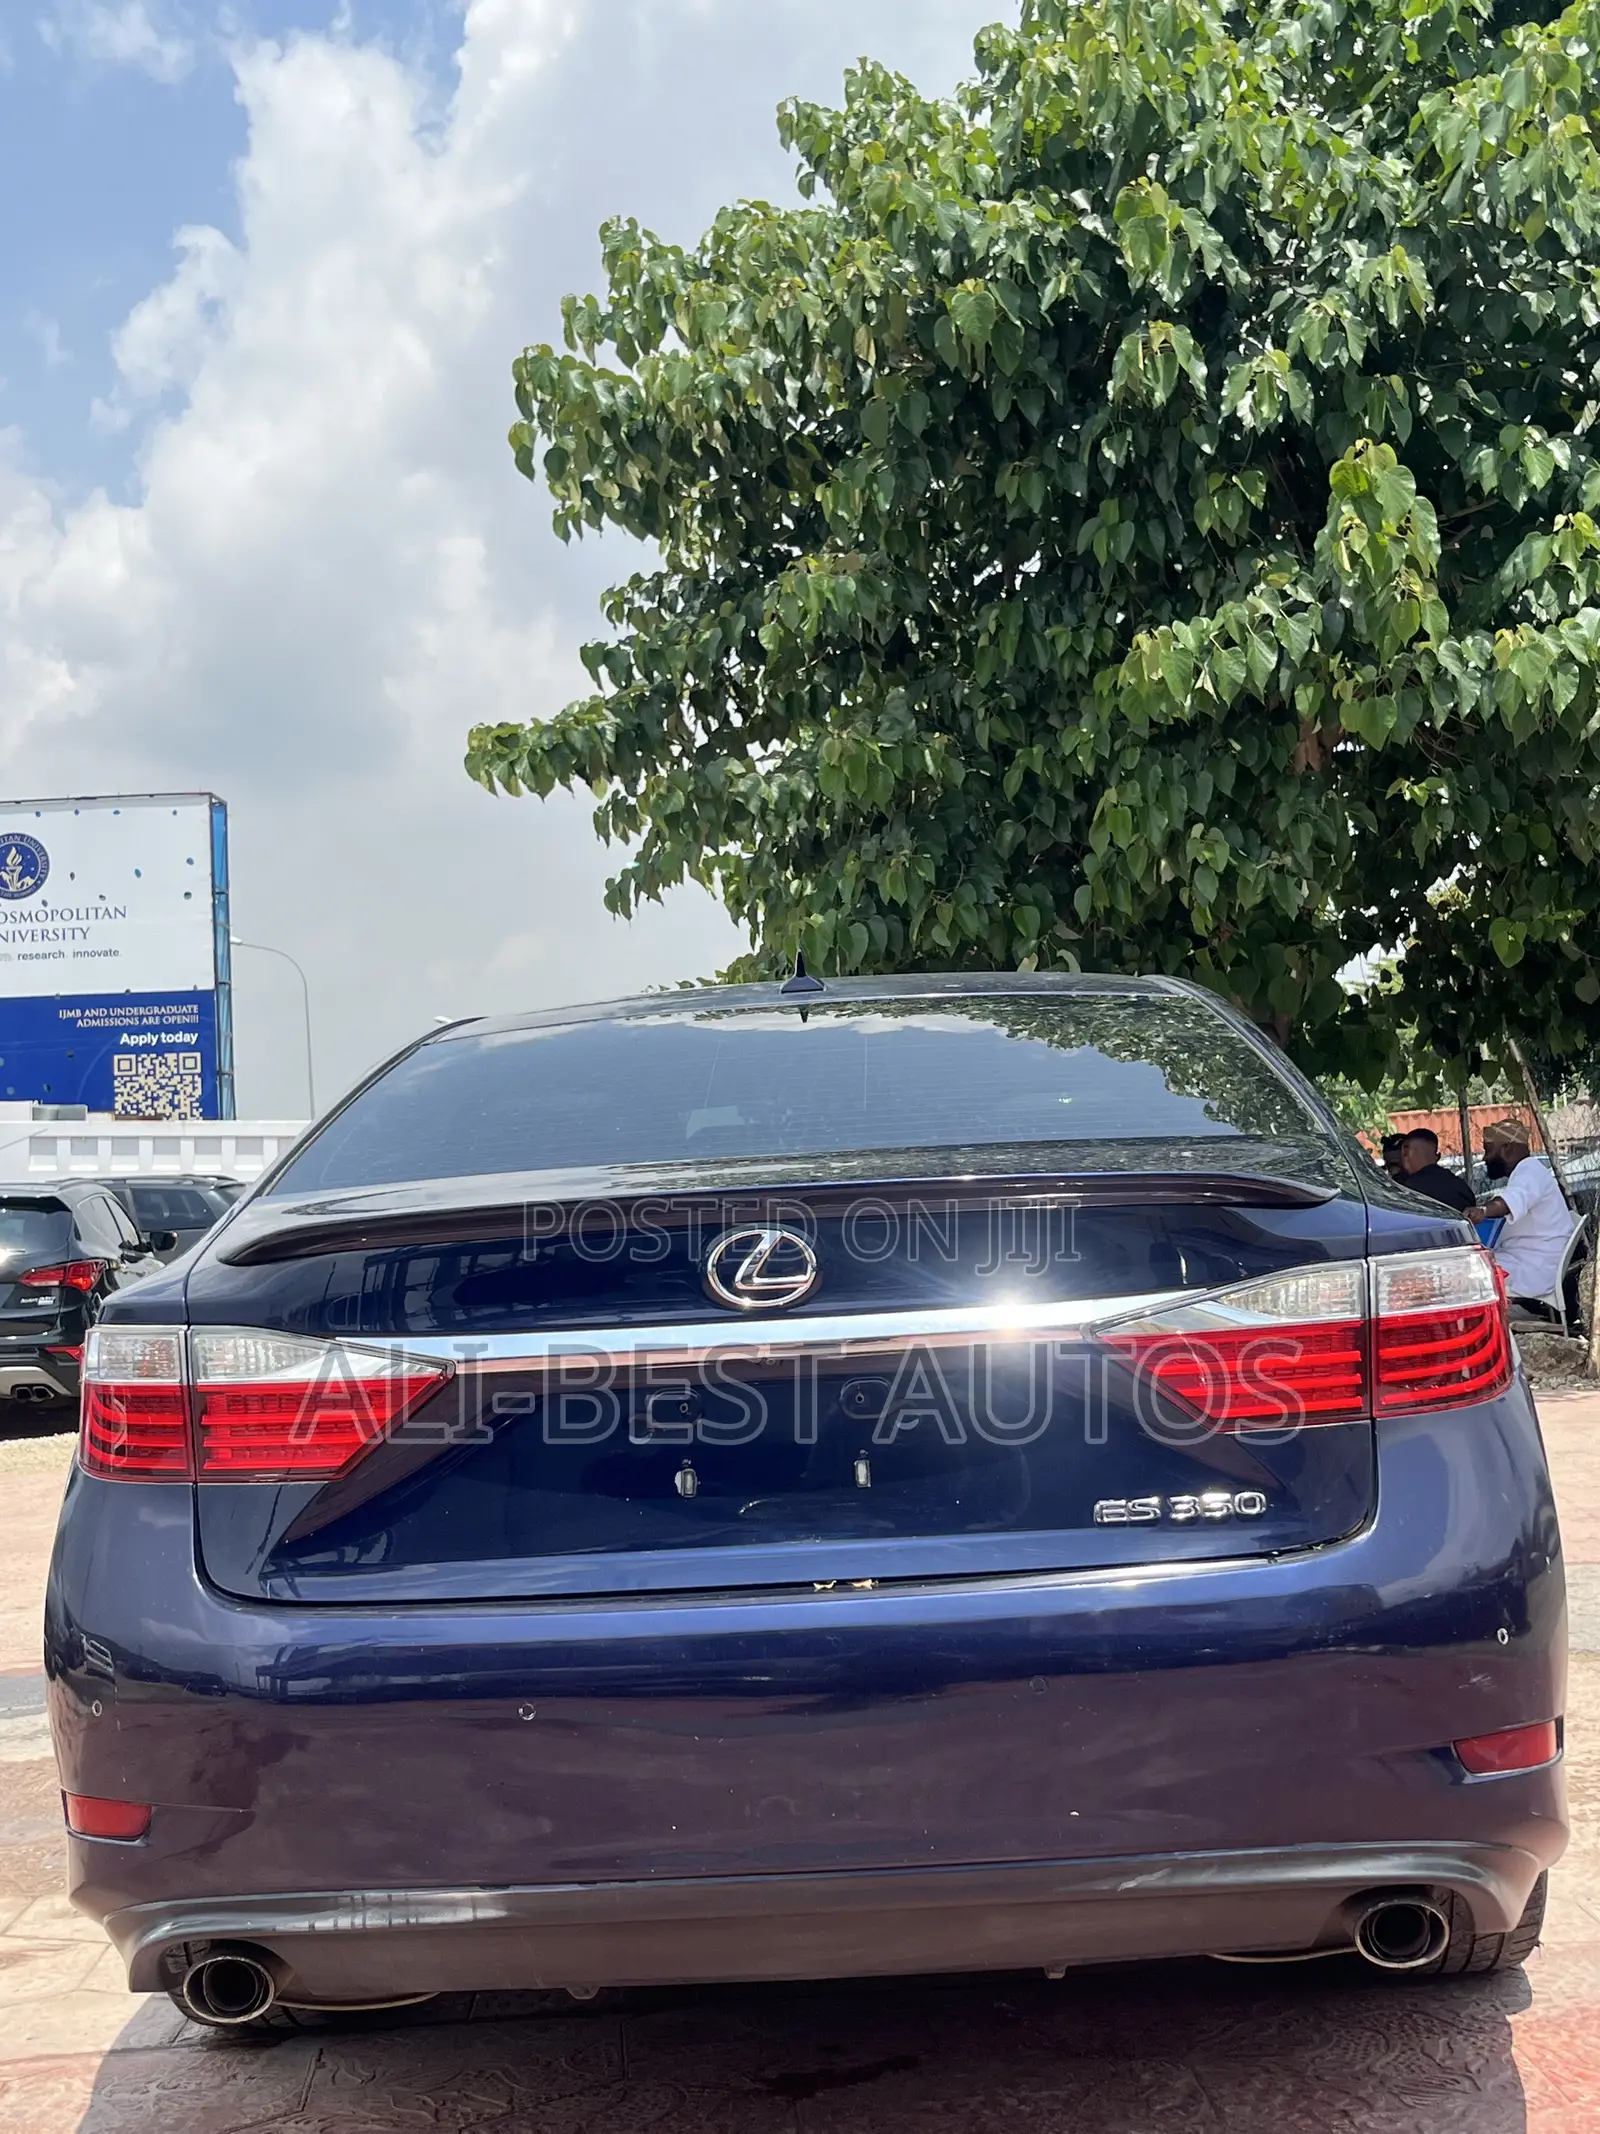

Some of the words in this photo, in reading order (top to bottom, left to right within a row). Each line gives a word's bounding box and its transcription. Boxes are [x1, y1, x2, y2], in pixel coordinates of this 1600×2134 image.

[84, 1008, 108, 1018] AND
[109, 1004, 199, 1016] UNDERGRADUATE
[76, 1018, 140, 1028] ADMISSIONS
[141, 1016, 161, 1026] ARE
[120, 1032, 159, 1047] Apply
[160, 1031, 199, 1045] today
[1093, 1496, 1161, 1525] ES
[1167, 1491, 1267, 1521] 350
